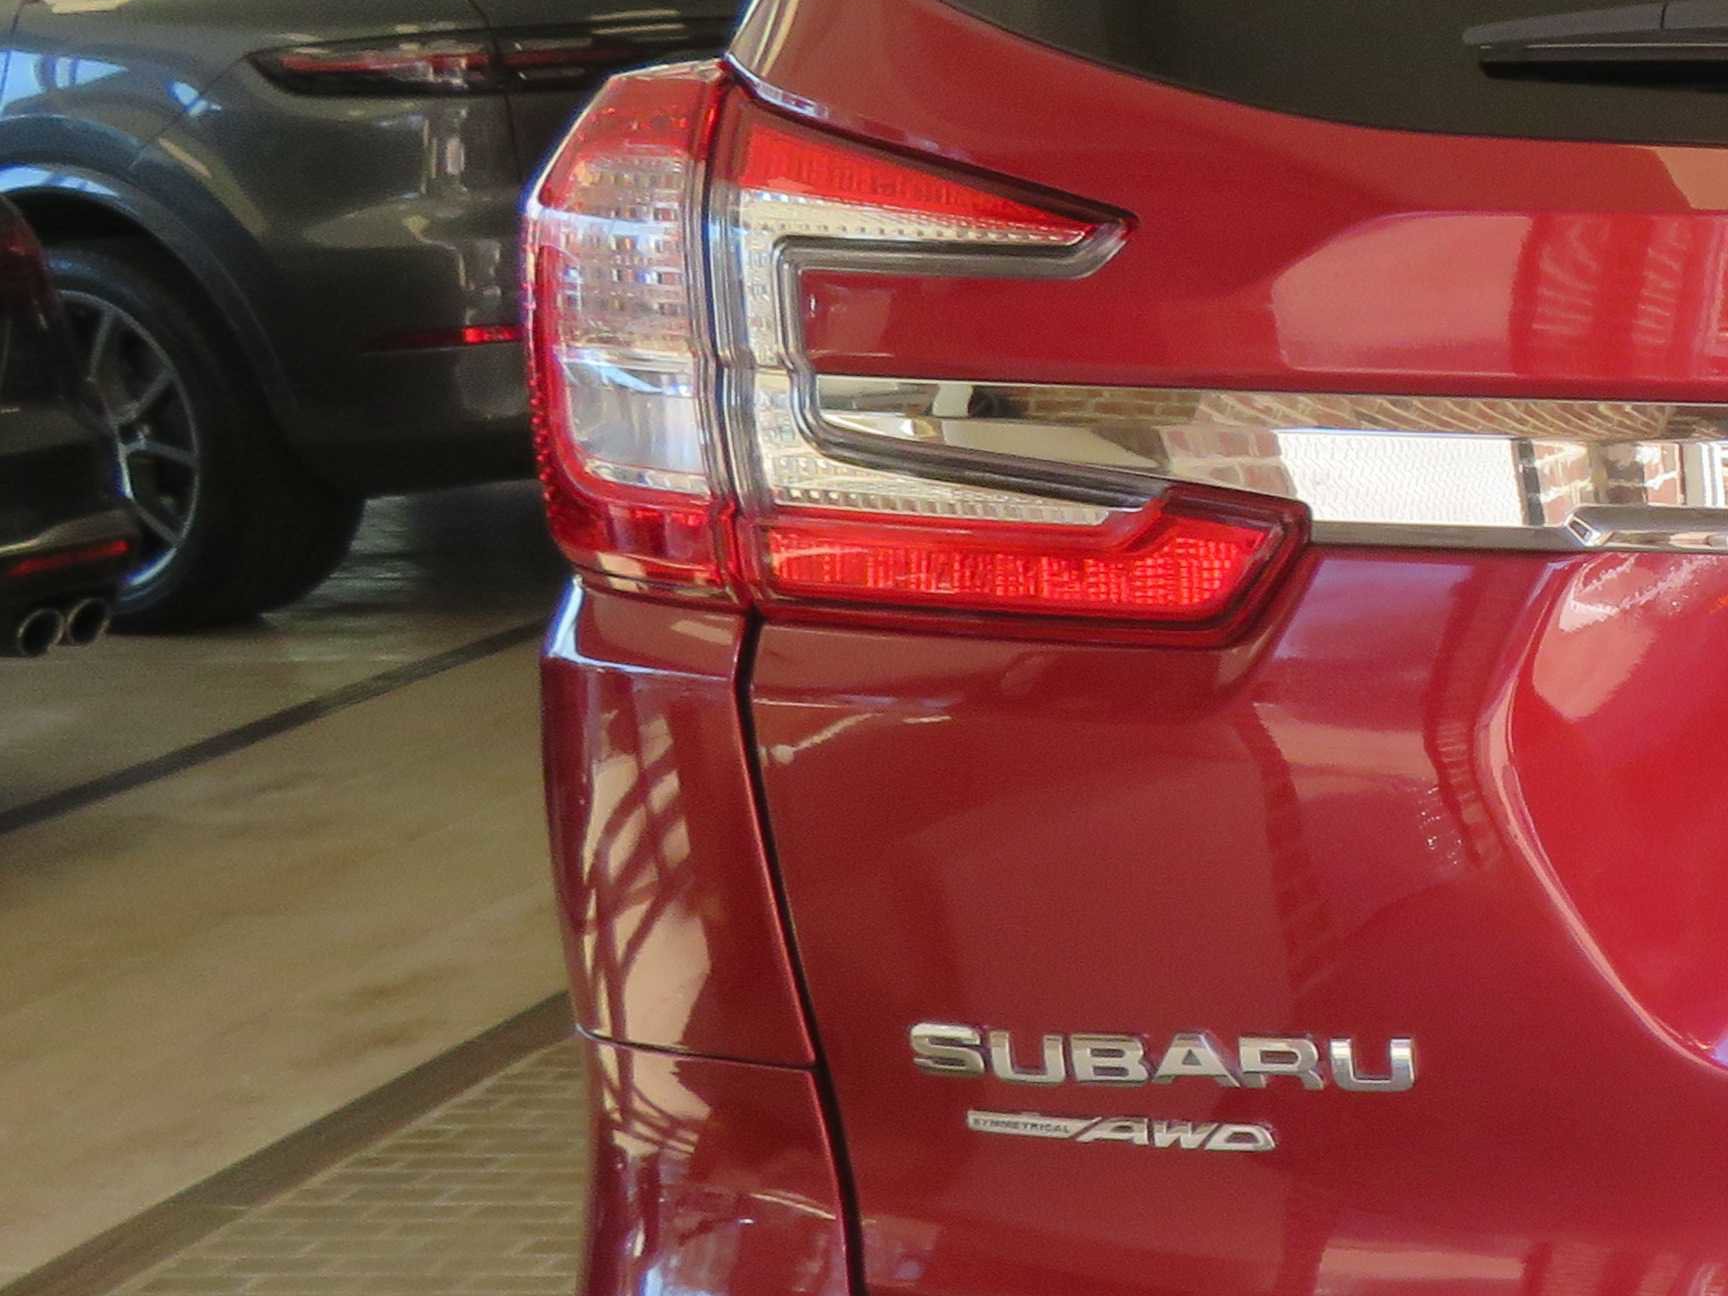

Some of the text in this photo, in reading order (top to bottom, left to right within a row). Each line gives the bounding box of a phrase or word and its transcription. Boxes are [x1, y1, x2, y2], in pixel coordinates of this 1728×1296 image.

[909, 1022, 1416, 1091] SUBARU
[972, 1116, 1276, 1151] SYMMETRICAL AWD
